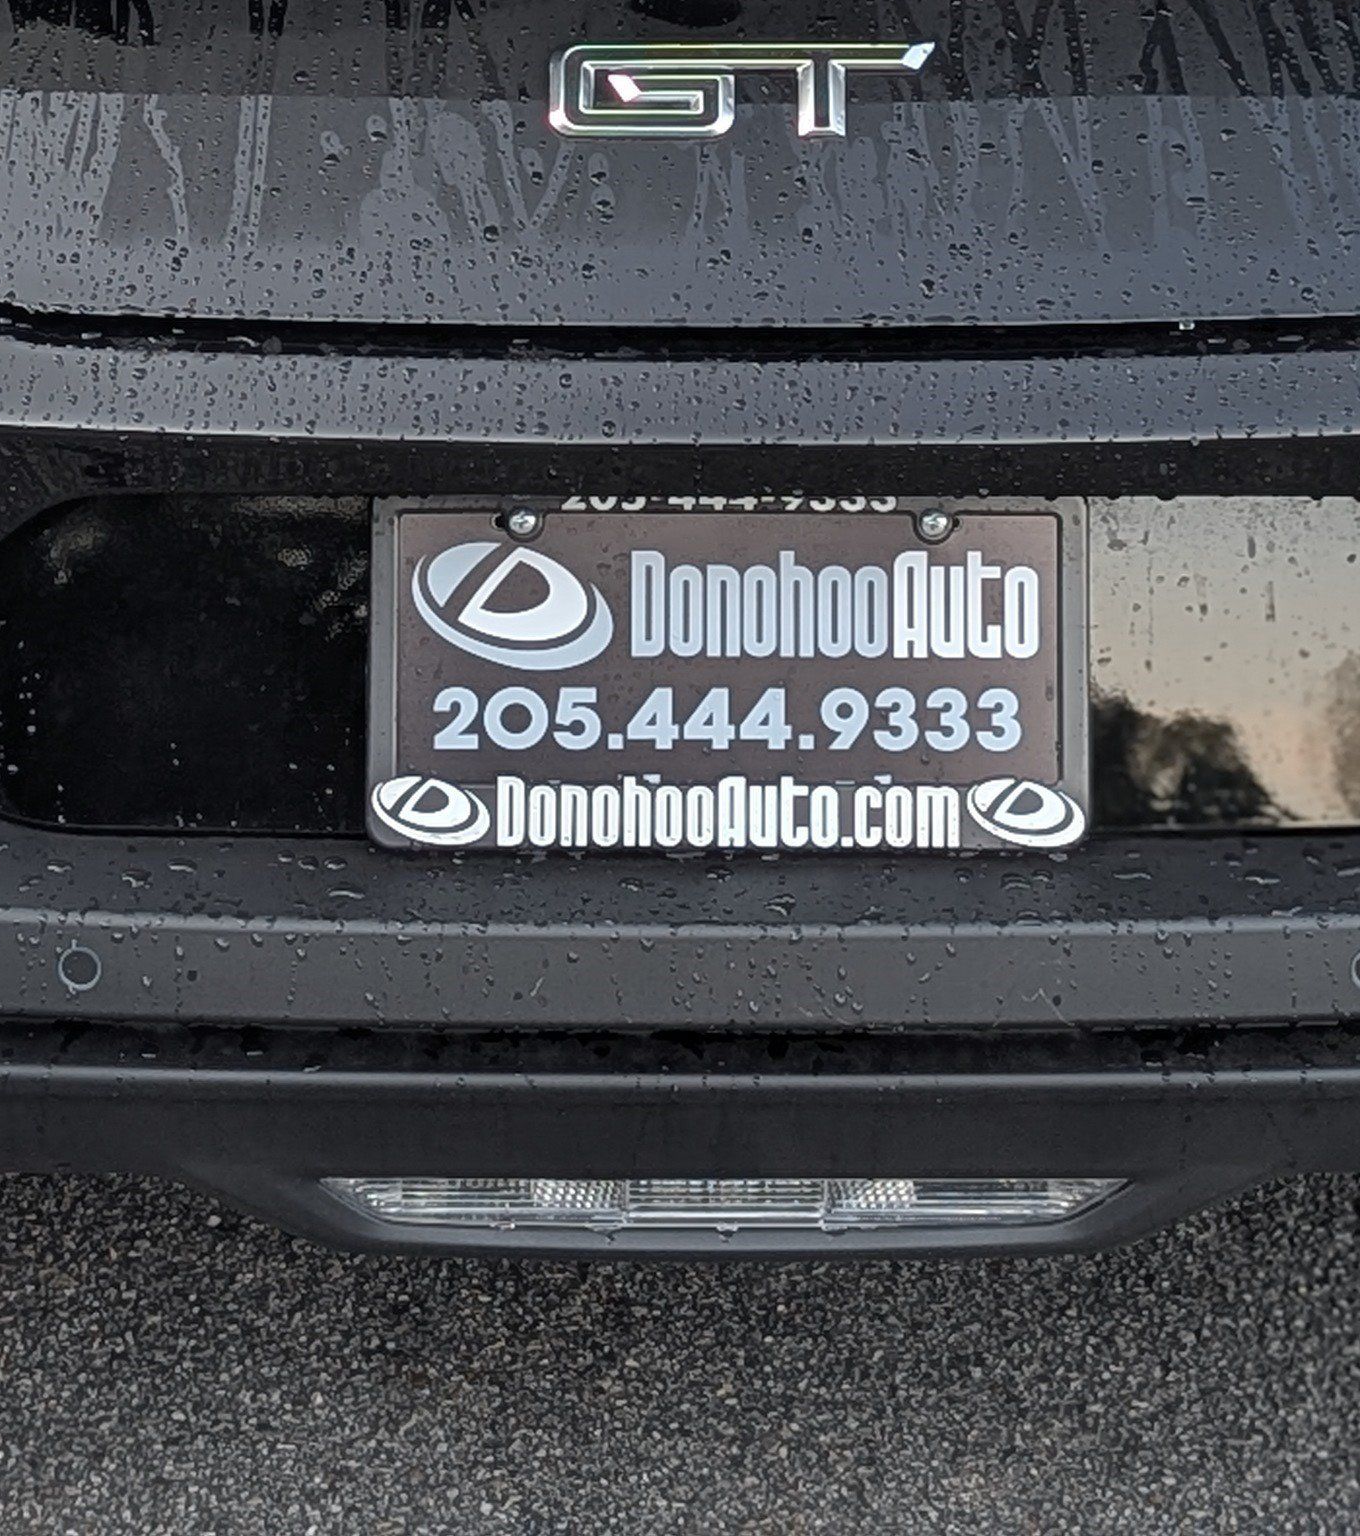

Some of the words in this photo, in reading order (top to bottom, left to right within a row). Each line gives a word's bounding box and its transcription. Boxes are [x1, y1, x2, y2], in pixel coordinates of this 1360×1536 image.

[549, 41, 935, 137] GT
[630, 550, 1040, 659] DonohooAuto
[432, 686, 1022, 751] 205.444.9333
[496, 775, 961, 848] DonohooAuto.com
